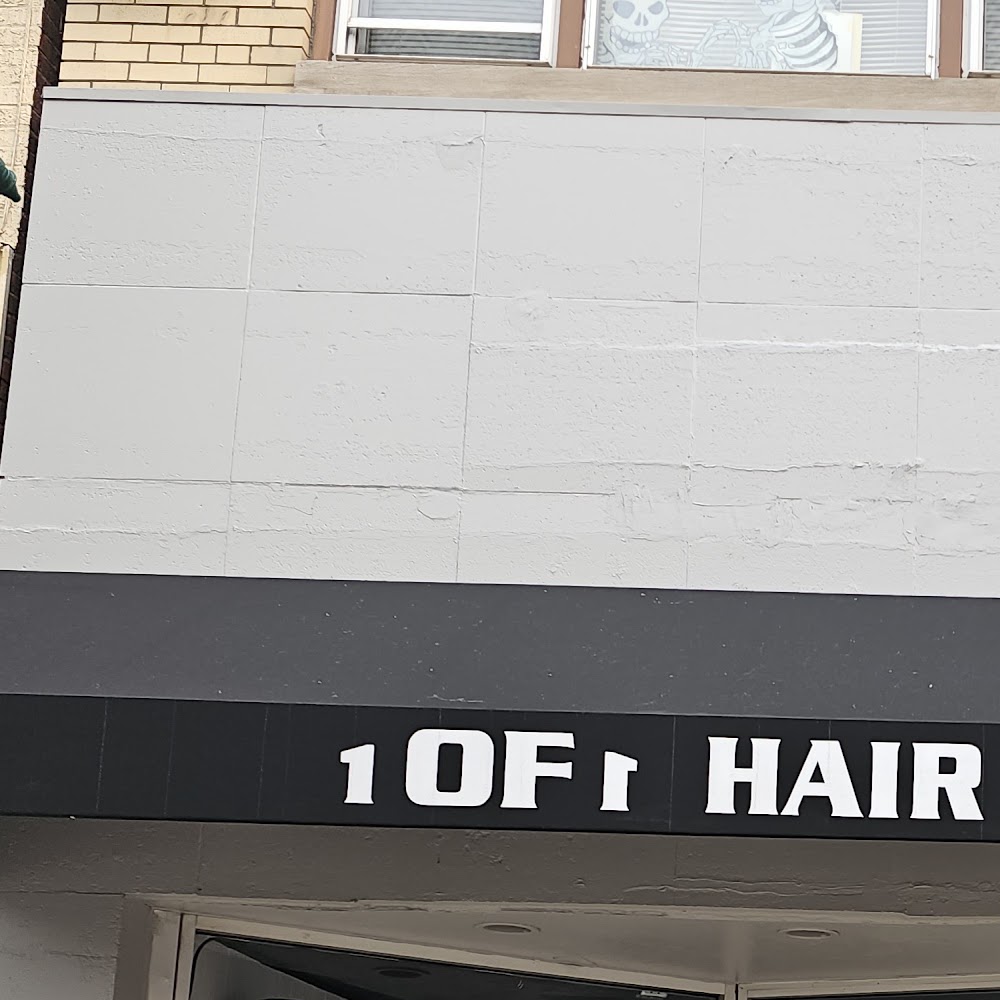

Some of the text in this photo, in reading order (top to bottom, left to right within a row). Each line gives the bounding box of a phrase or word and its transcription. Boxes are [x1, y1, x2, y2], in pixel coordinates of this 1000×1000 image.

[339, 743, 375, 805] 1
[404, 728, 576, 809] OF
[599, 750, 639, 812] 1
[704, 735, 985, 821] HAIR
